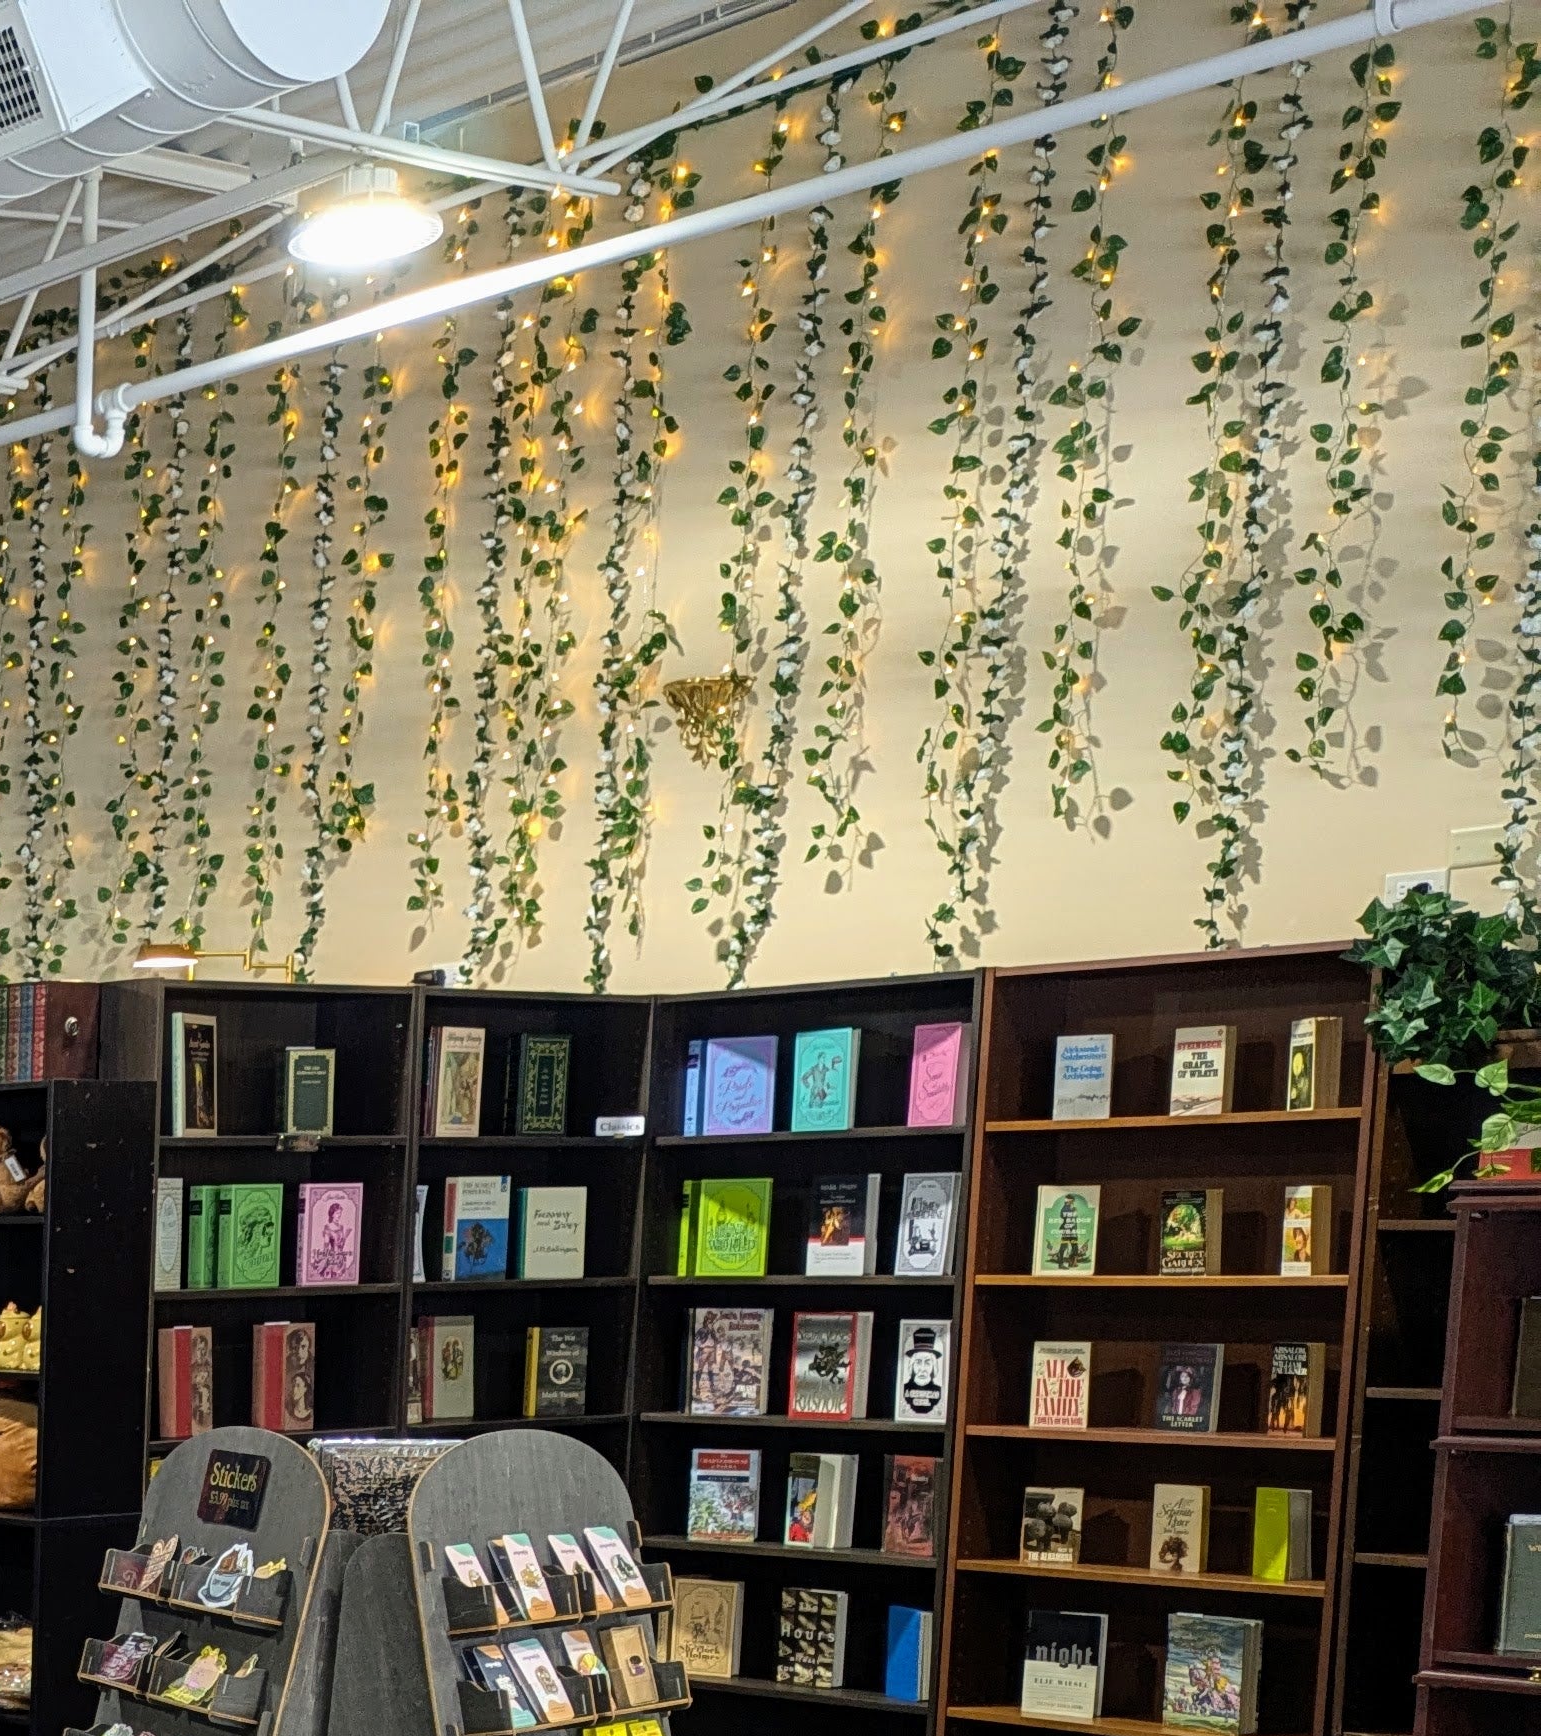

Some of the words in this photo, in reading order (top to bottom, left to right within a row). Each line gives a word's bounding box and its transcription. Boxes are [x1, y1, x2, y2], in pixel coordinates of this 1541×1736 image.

[1177, 1040, 1223, 1049] STEINBECK
[1191, 1052, 1208, 1060] THE
[1182, 1060, 1214, 1069] GRAPES
[1177, 1069, 1188, 1078] OF
[1189, 1068, 1219, 1079] WRATH
[600, 1122, 641, 1131] Classics
[1167, 1250, 1205, 1260] SECRET
[1162, 1258, 1204, 1269] GARDEN
[1045, 1359, 1067, 1378] ALL
[1036, 1378, 1050, 1397] IN
[1058, 1378, 1085, 1397] THE
[1035, 1398, 1079, 1417] FAMILY
[210, 1462, 257, 1492] Stickers
[781, 1624, 835, 1643] Hours
[1036, 1642, 1093, 1669] night
[1057, 1679, 1088, 1688] WIESEL
